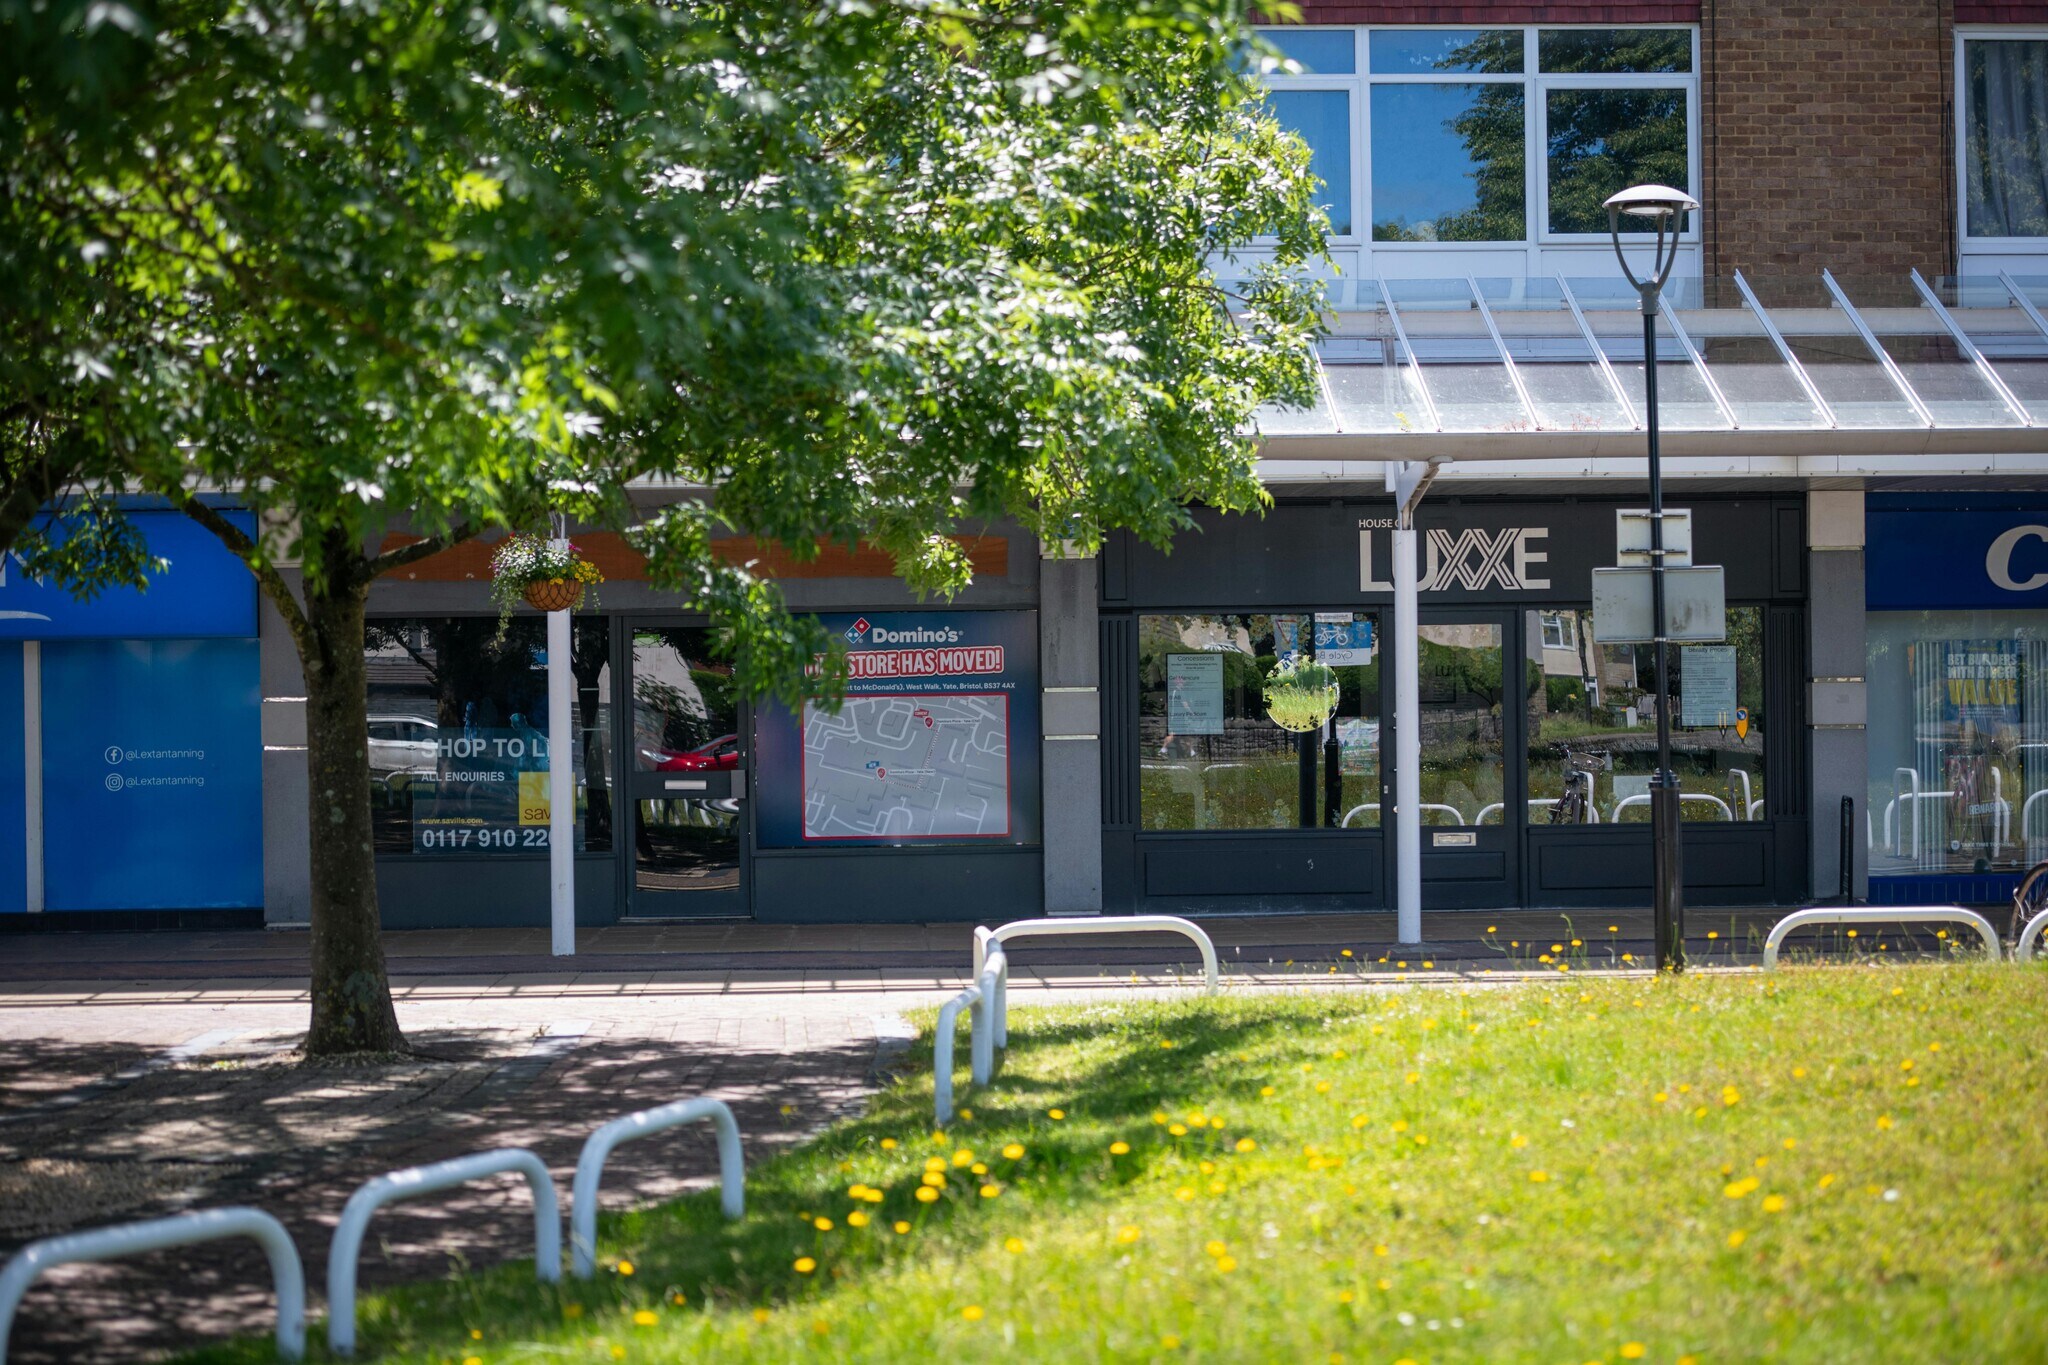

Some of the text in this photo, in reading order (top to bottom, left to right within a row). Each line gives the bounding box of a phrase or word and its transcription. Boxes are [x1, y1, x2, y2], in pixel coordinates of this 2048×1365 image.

[1358, 519, 1393, 528] HOUSE
[872, 626, 958, 643] Domino's
[847, 653, 897, 675] STORE
[901, 652, 935, 674] HAS
[939, 649, 1001, 672] MOVED!
[1947, 653, 1966, 665] BET
[1947, 666, 1975, 679] WITH
[862, 683, 905, 692] McDonald's),
[924, 682, 942, 690] Walk,
[942, 682, 958, 690] Yate,
[959, 681, 983, 690] Bristol,
[983, 681, 1000, 689] BS37
[1947, 679, 2017, 705] VALUE
[421, 737, 487, 758] SHOP
[493, 738, 525, 758] TO
[125, 749, 205, 760] @Lextantanning
[125, 776, 205, 788] @Lextantanning
[421, 771, 505, 782] ALL ENQUIRIES
[422, 829, 551, 848] 0117 910 22
